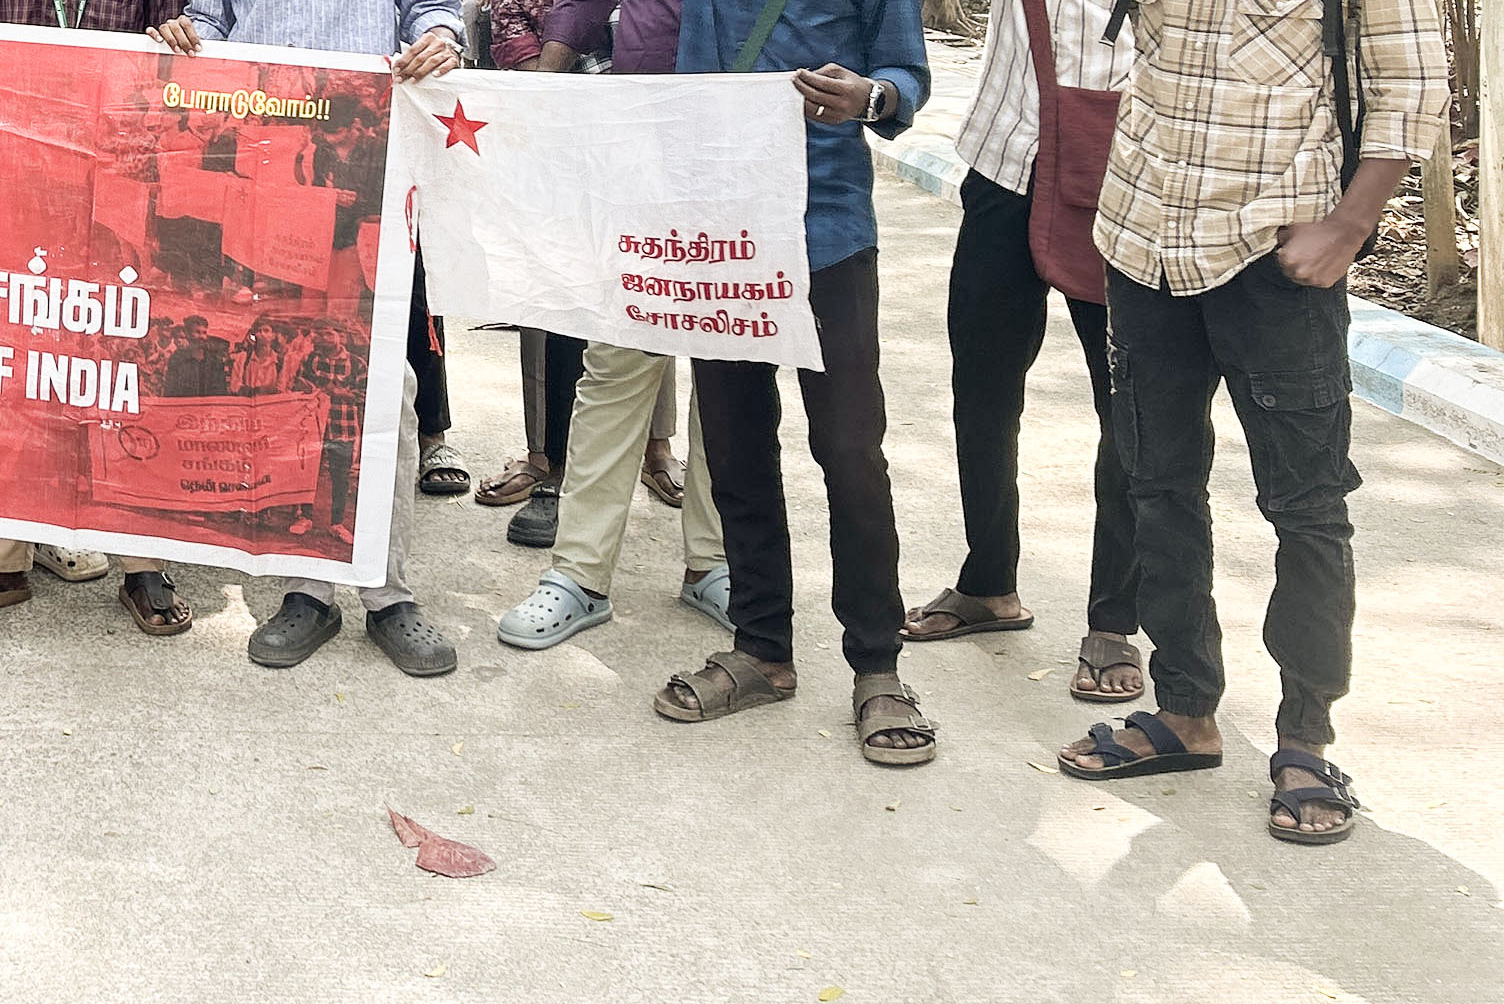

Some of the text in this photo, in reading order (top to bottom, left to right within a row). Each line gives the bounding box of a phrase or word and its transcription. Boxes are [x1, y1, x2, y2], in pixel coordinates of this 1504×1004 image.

[163, 82, 331, 121] போராடுவோம்!!
[618, 229, 756, 264] சுதந்திரம்
[622, 271, 794, 303] ஜனநாயகம்
[626, 304, 779, 338] சோசலிசம்
[26, 349, 142, 415] INDIA
